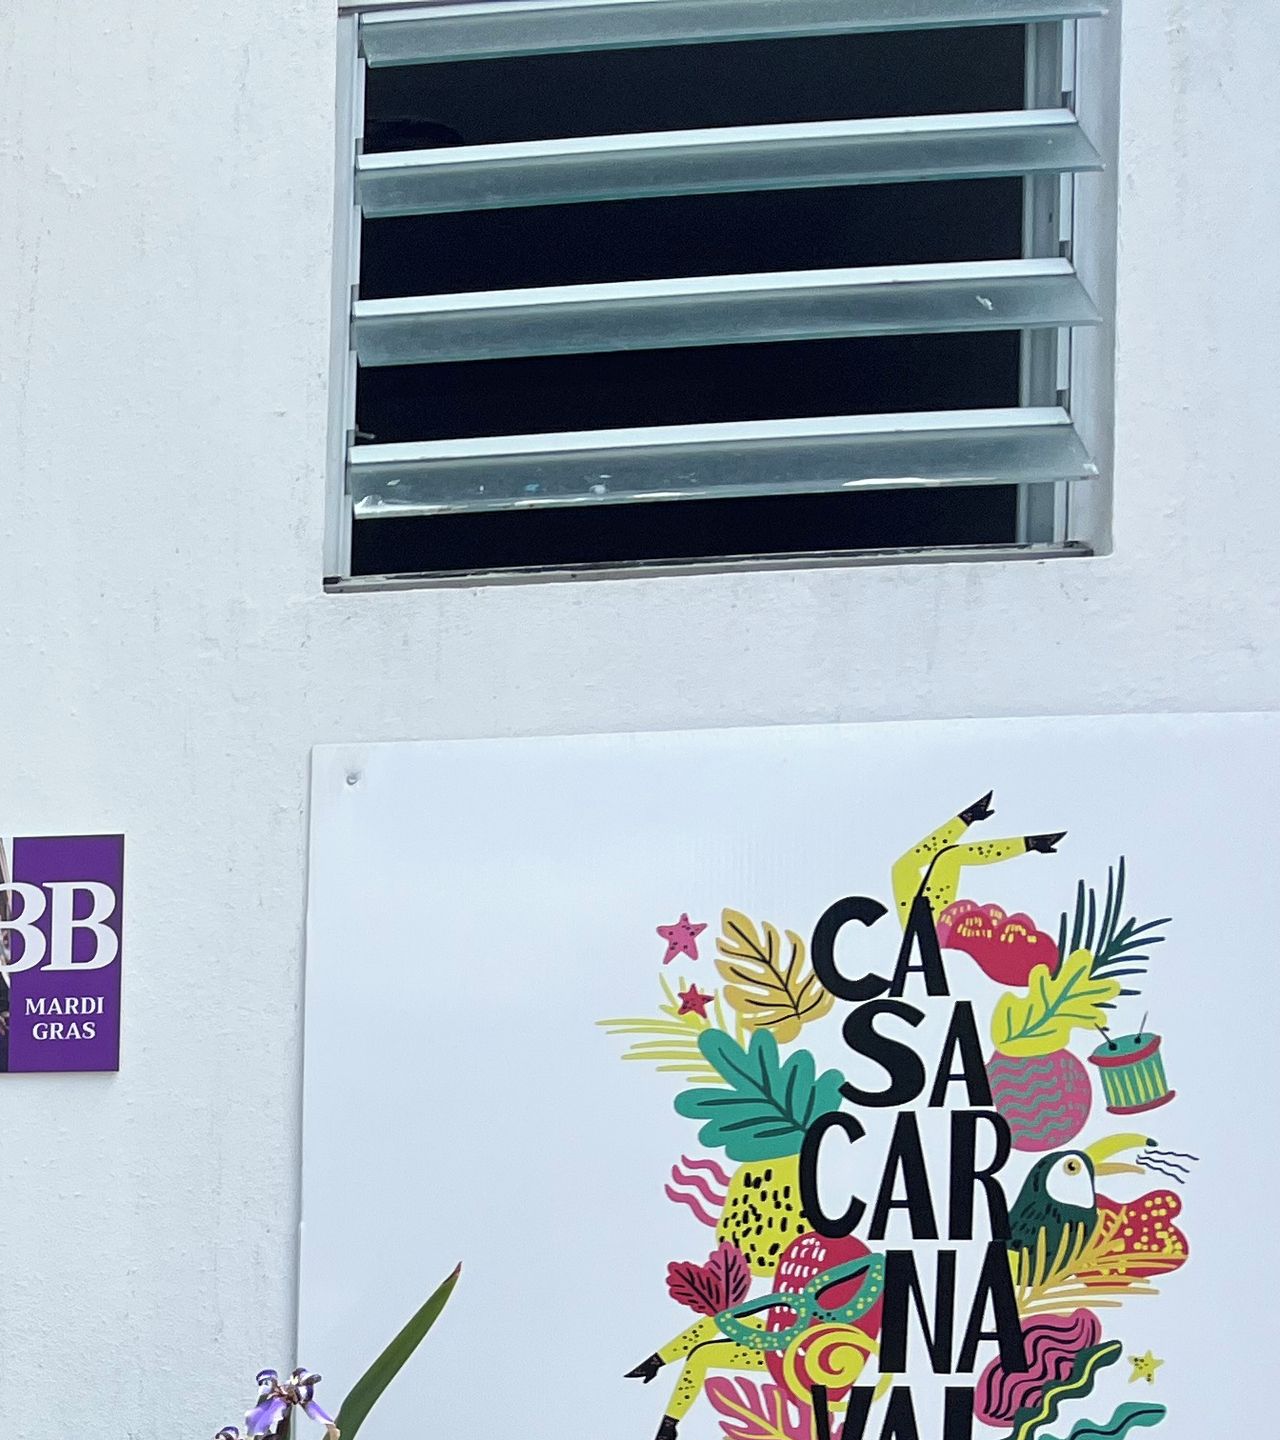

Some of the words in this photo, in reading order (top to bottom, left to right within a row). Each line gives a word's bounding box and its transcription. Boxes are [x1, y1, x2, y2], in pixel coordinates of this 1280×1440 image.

[810, 895, 950, 1001] CA
[25, 996, 105, 1016] MARDI
[32, 1021, 96, 1040] GRAS
[839, 1000, 994, 1108] SA
[798, 1110, 1013, 1241] CAR
[877, 1241, 1029, 1375] NA
